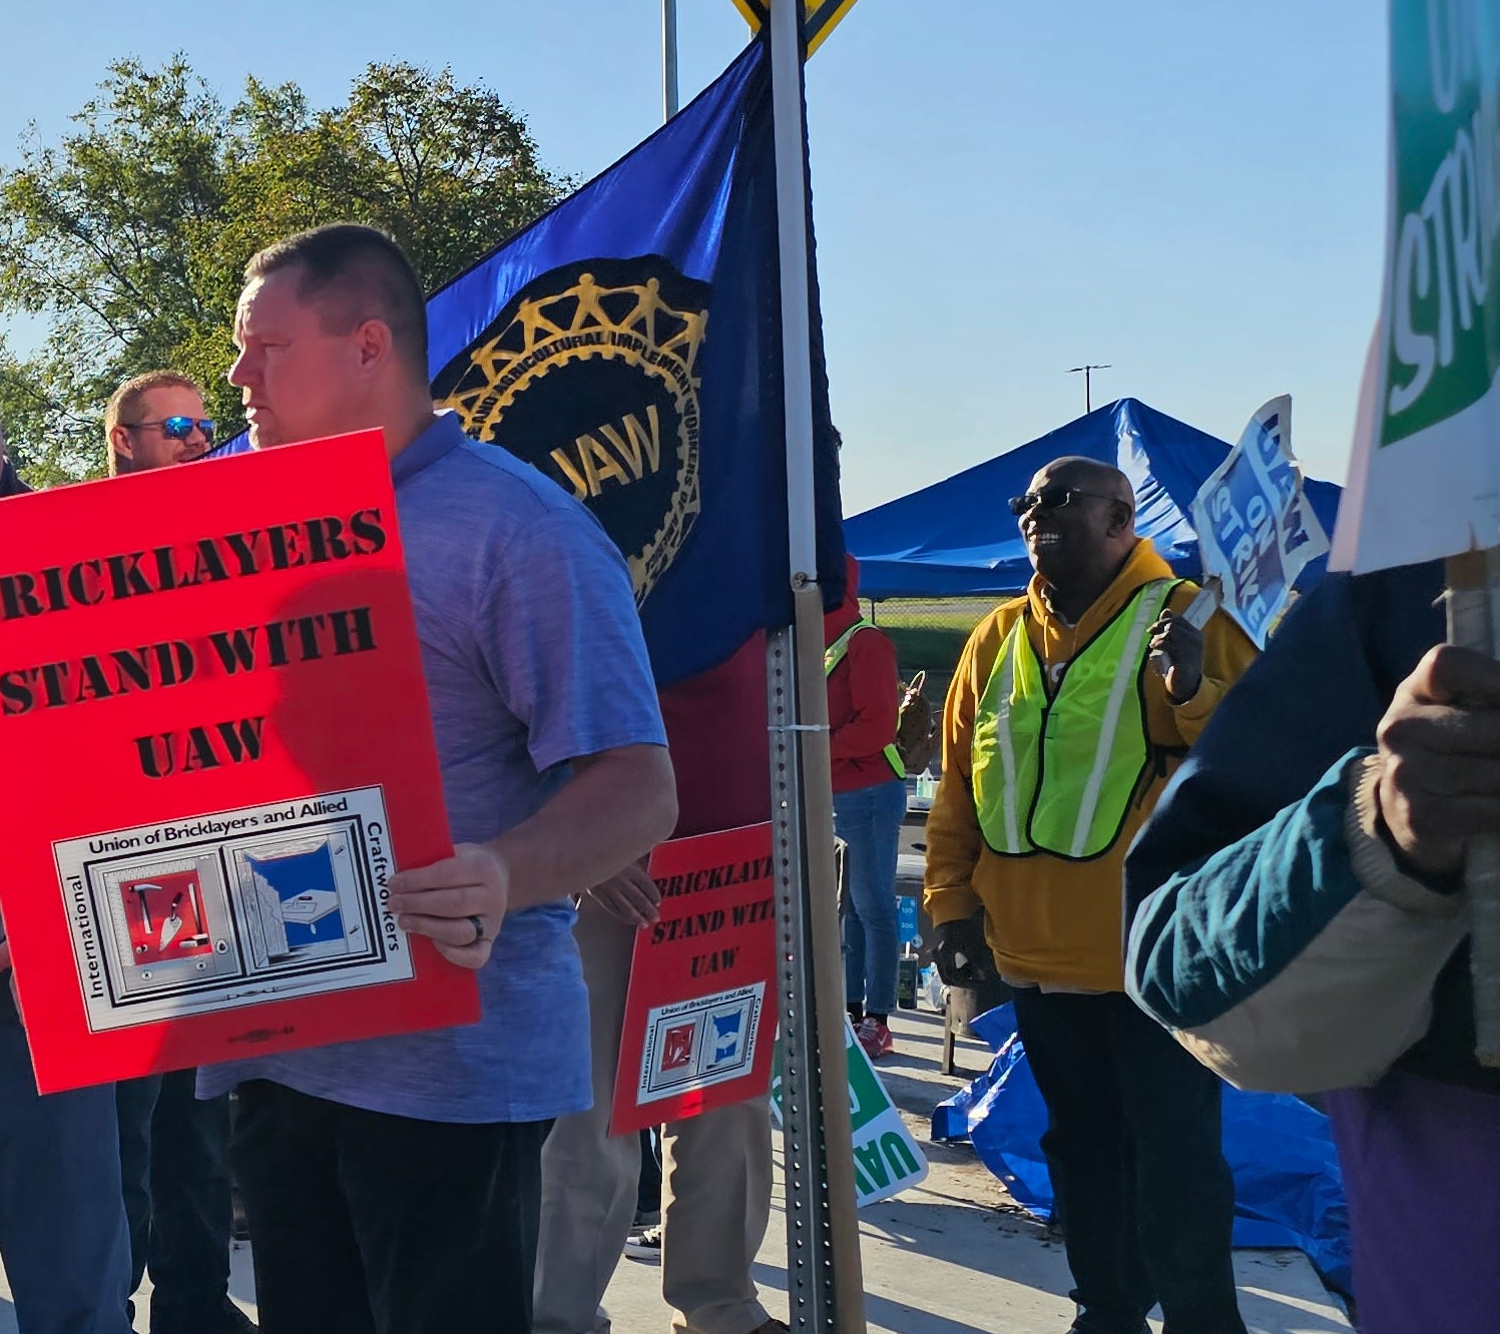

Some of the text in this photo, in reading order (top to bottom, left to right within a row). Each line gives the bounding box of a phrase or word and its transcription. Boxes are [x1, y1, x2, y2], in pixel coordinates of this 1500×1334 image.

[472, 397, 499, 423] AND
[493, 331, 605, 396] AGRICULTURAL
[611, 331, 691, 396] IMPLEMENT
[1258, 413, 1310, 555] UAW
[1247, 495, 1276, 554] ON
[1212, 486, 1267, 634] STRIKE
[206, 607, 379, 676] WITH
[133, 716, 265, 779] UAW
[89, 797, 349, 855] Union of Bricklayers and Allied
[66, 873, 104, 1000] International
[652, 896, 774, 945] STAND WIT
[691, 946, 740, 977] UAW
